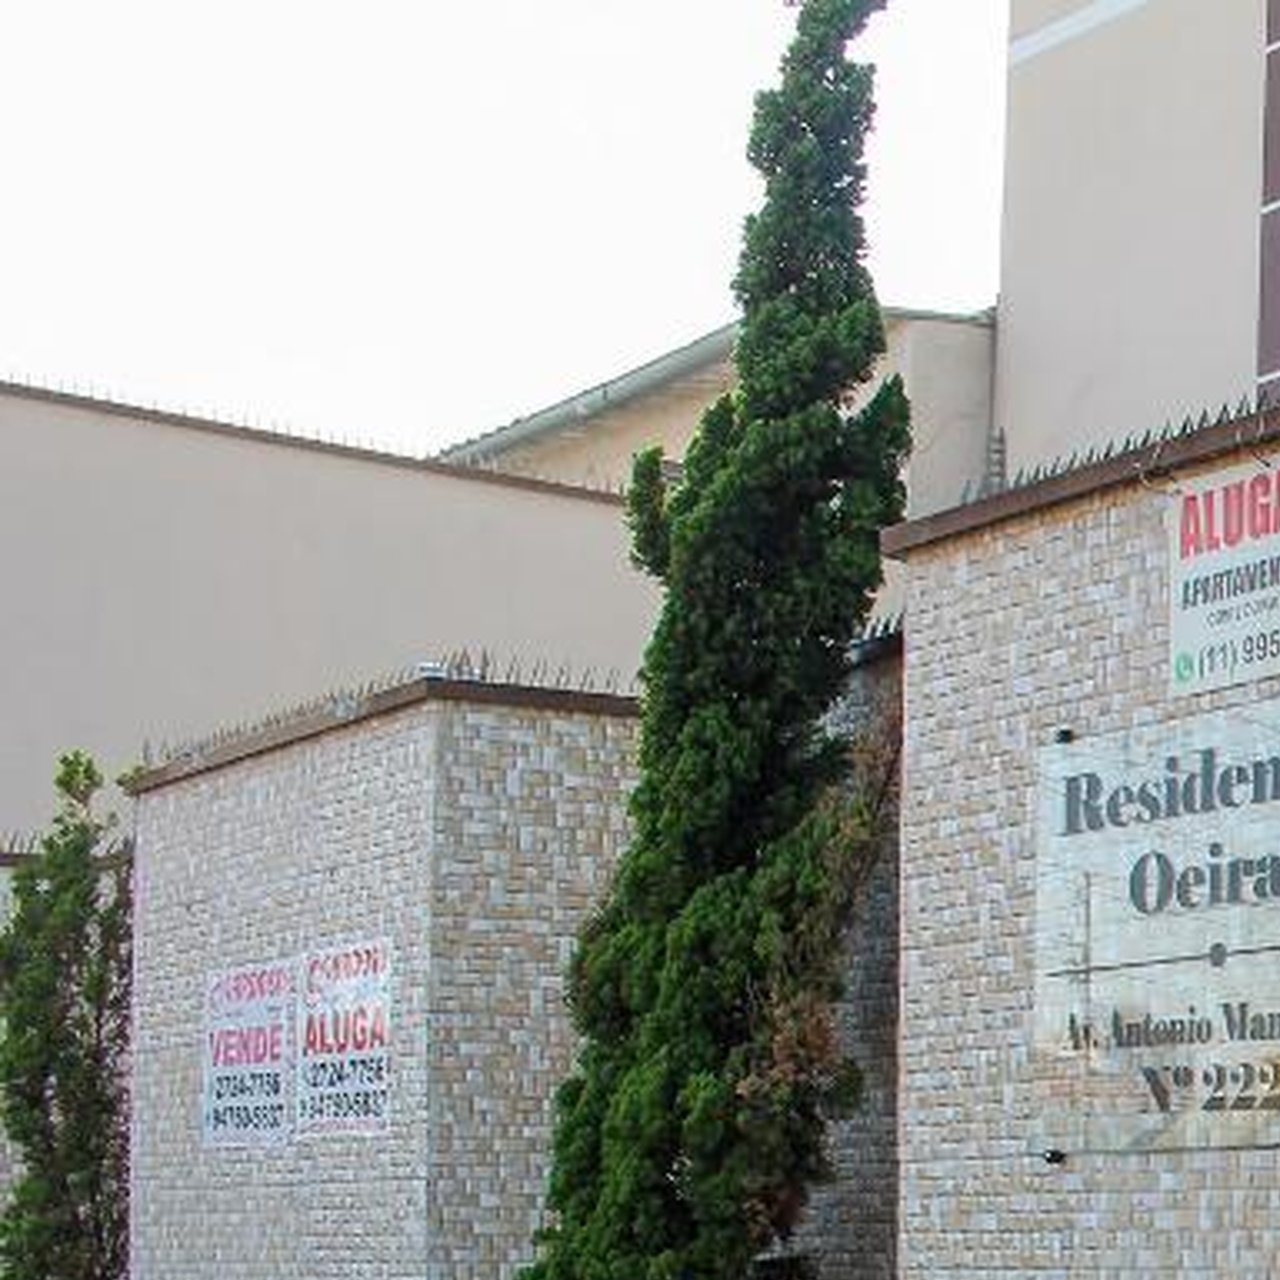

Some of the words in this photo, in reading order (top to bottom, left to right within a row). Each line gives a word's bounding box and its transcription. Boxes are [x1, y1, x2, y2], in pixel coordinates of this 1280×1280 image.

[1199, 638, 1238, 679] (11)
[209, 1025, 283, 1067] VENDE
[303, 1006, 386, 1056] ALUGA
[1109, 1006, 1213, 1050] Antonio
